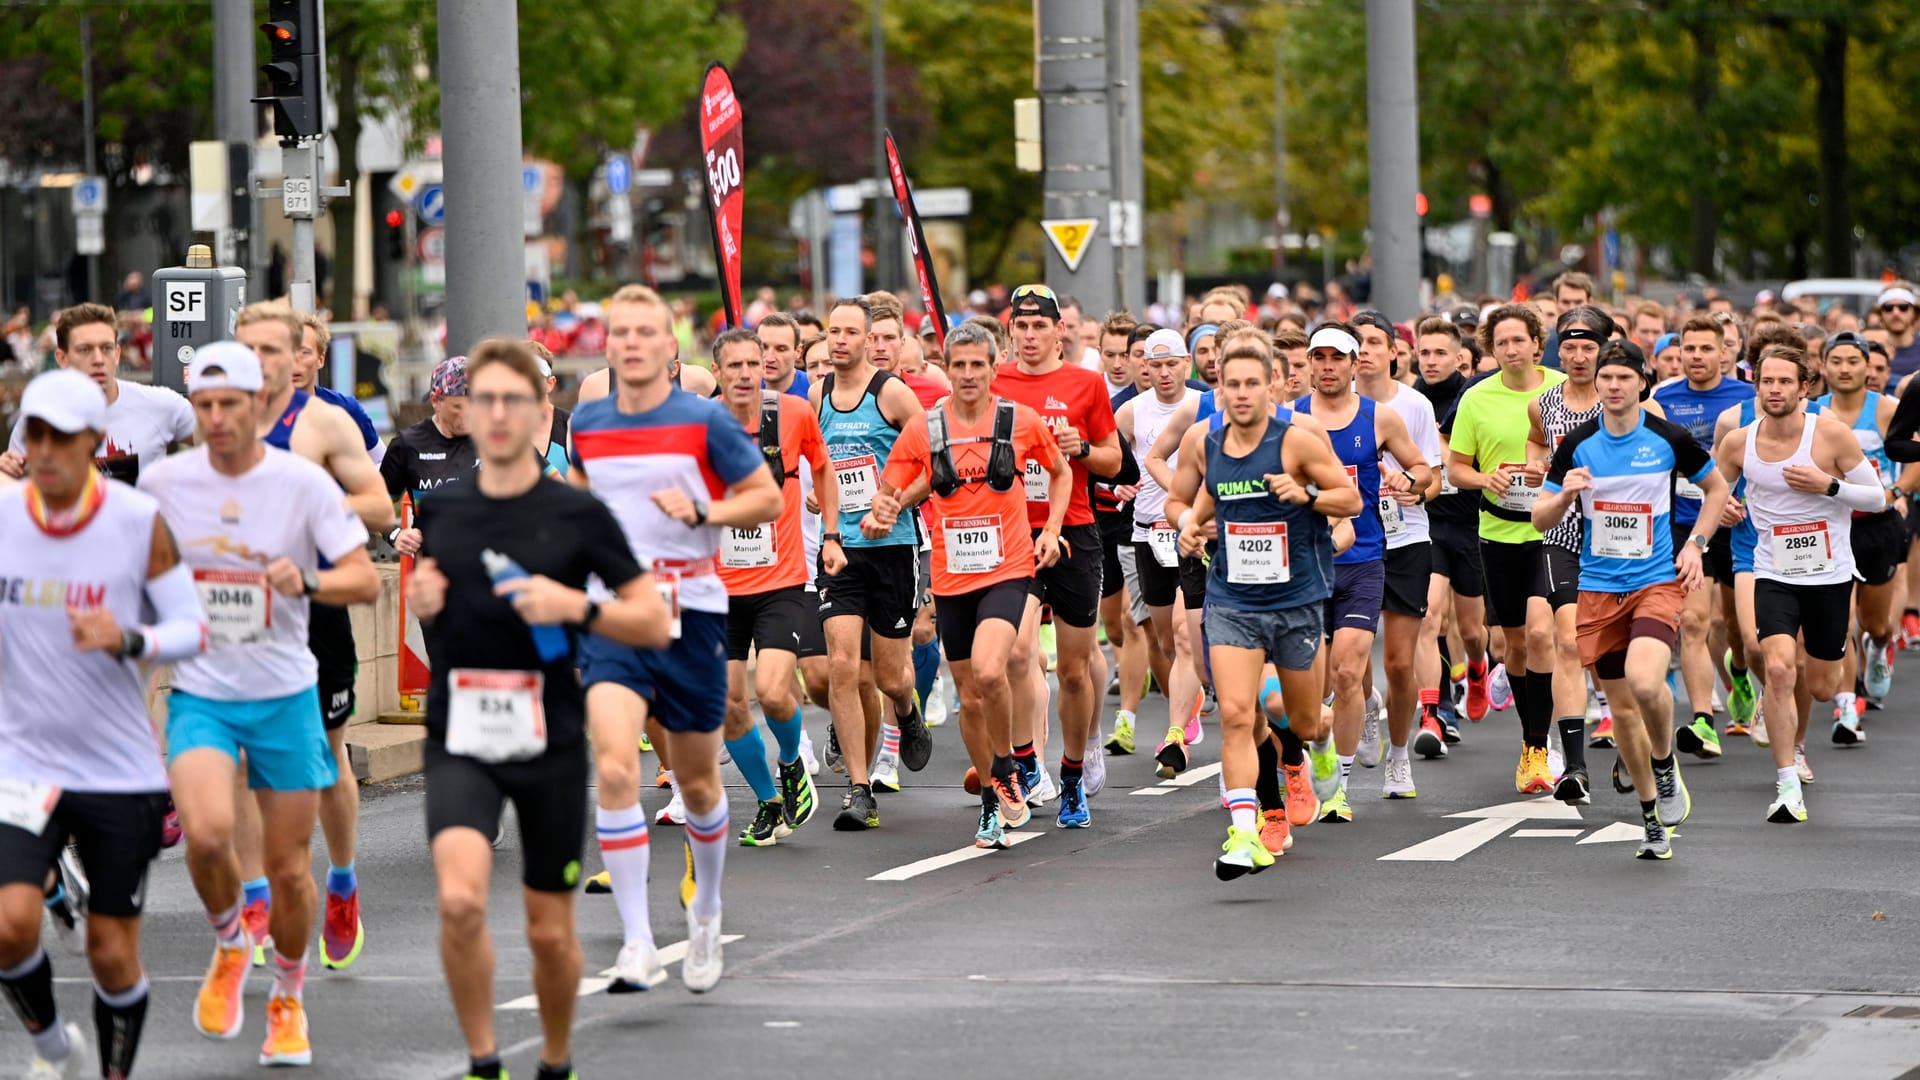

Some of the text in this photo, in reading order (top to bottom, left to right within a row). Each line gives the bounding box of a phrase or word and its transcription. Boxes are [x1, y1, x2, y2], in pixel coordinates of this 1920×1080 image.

[709, 147, 740, 207] 3:00
[286, 182, 310, 193] SIG.
[287, 197, 308, 208] 871
[1064, 225, 1078, 251] 2
[170, 291, 202, 312] SF
[172, 322, 192, 338] 871
[838, 470, 865, 485] 1911
[1217, 480, 1253, 495] PUMA
[1605, 515, 1638, 529] 3062
[731, 527, 762, 540] 1402
[956, 531, 988, 544] 1970
[734, 544, 761, 552] Manuel
[1239, 539, 1272, 552] 4202
[1785, 535, 1817, 549] 2892
[956, 549, 992, 557] Alexander
[1242, 558, 1271, 566] Markus
[208, 588, 253, 607] 3046
